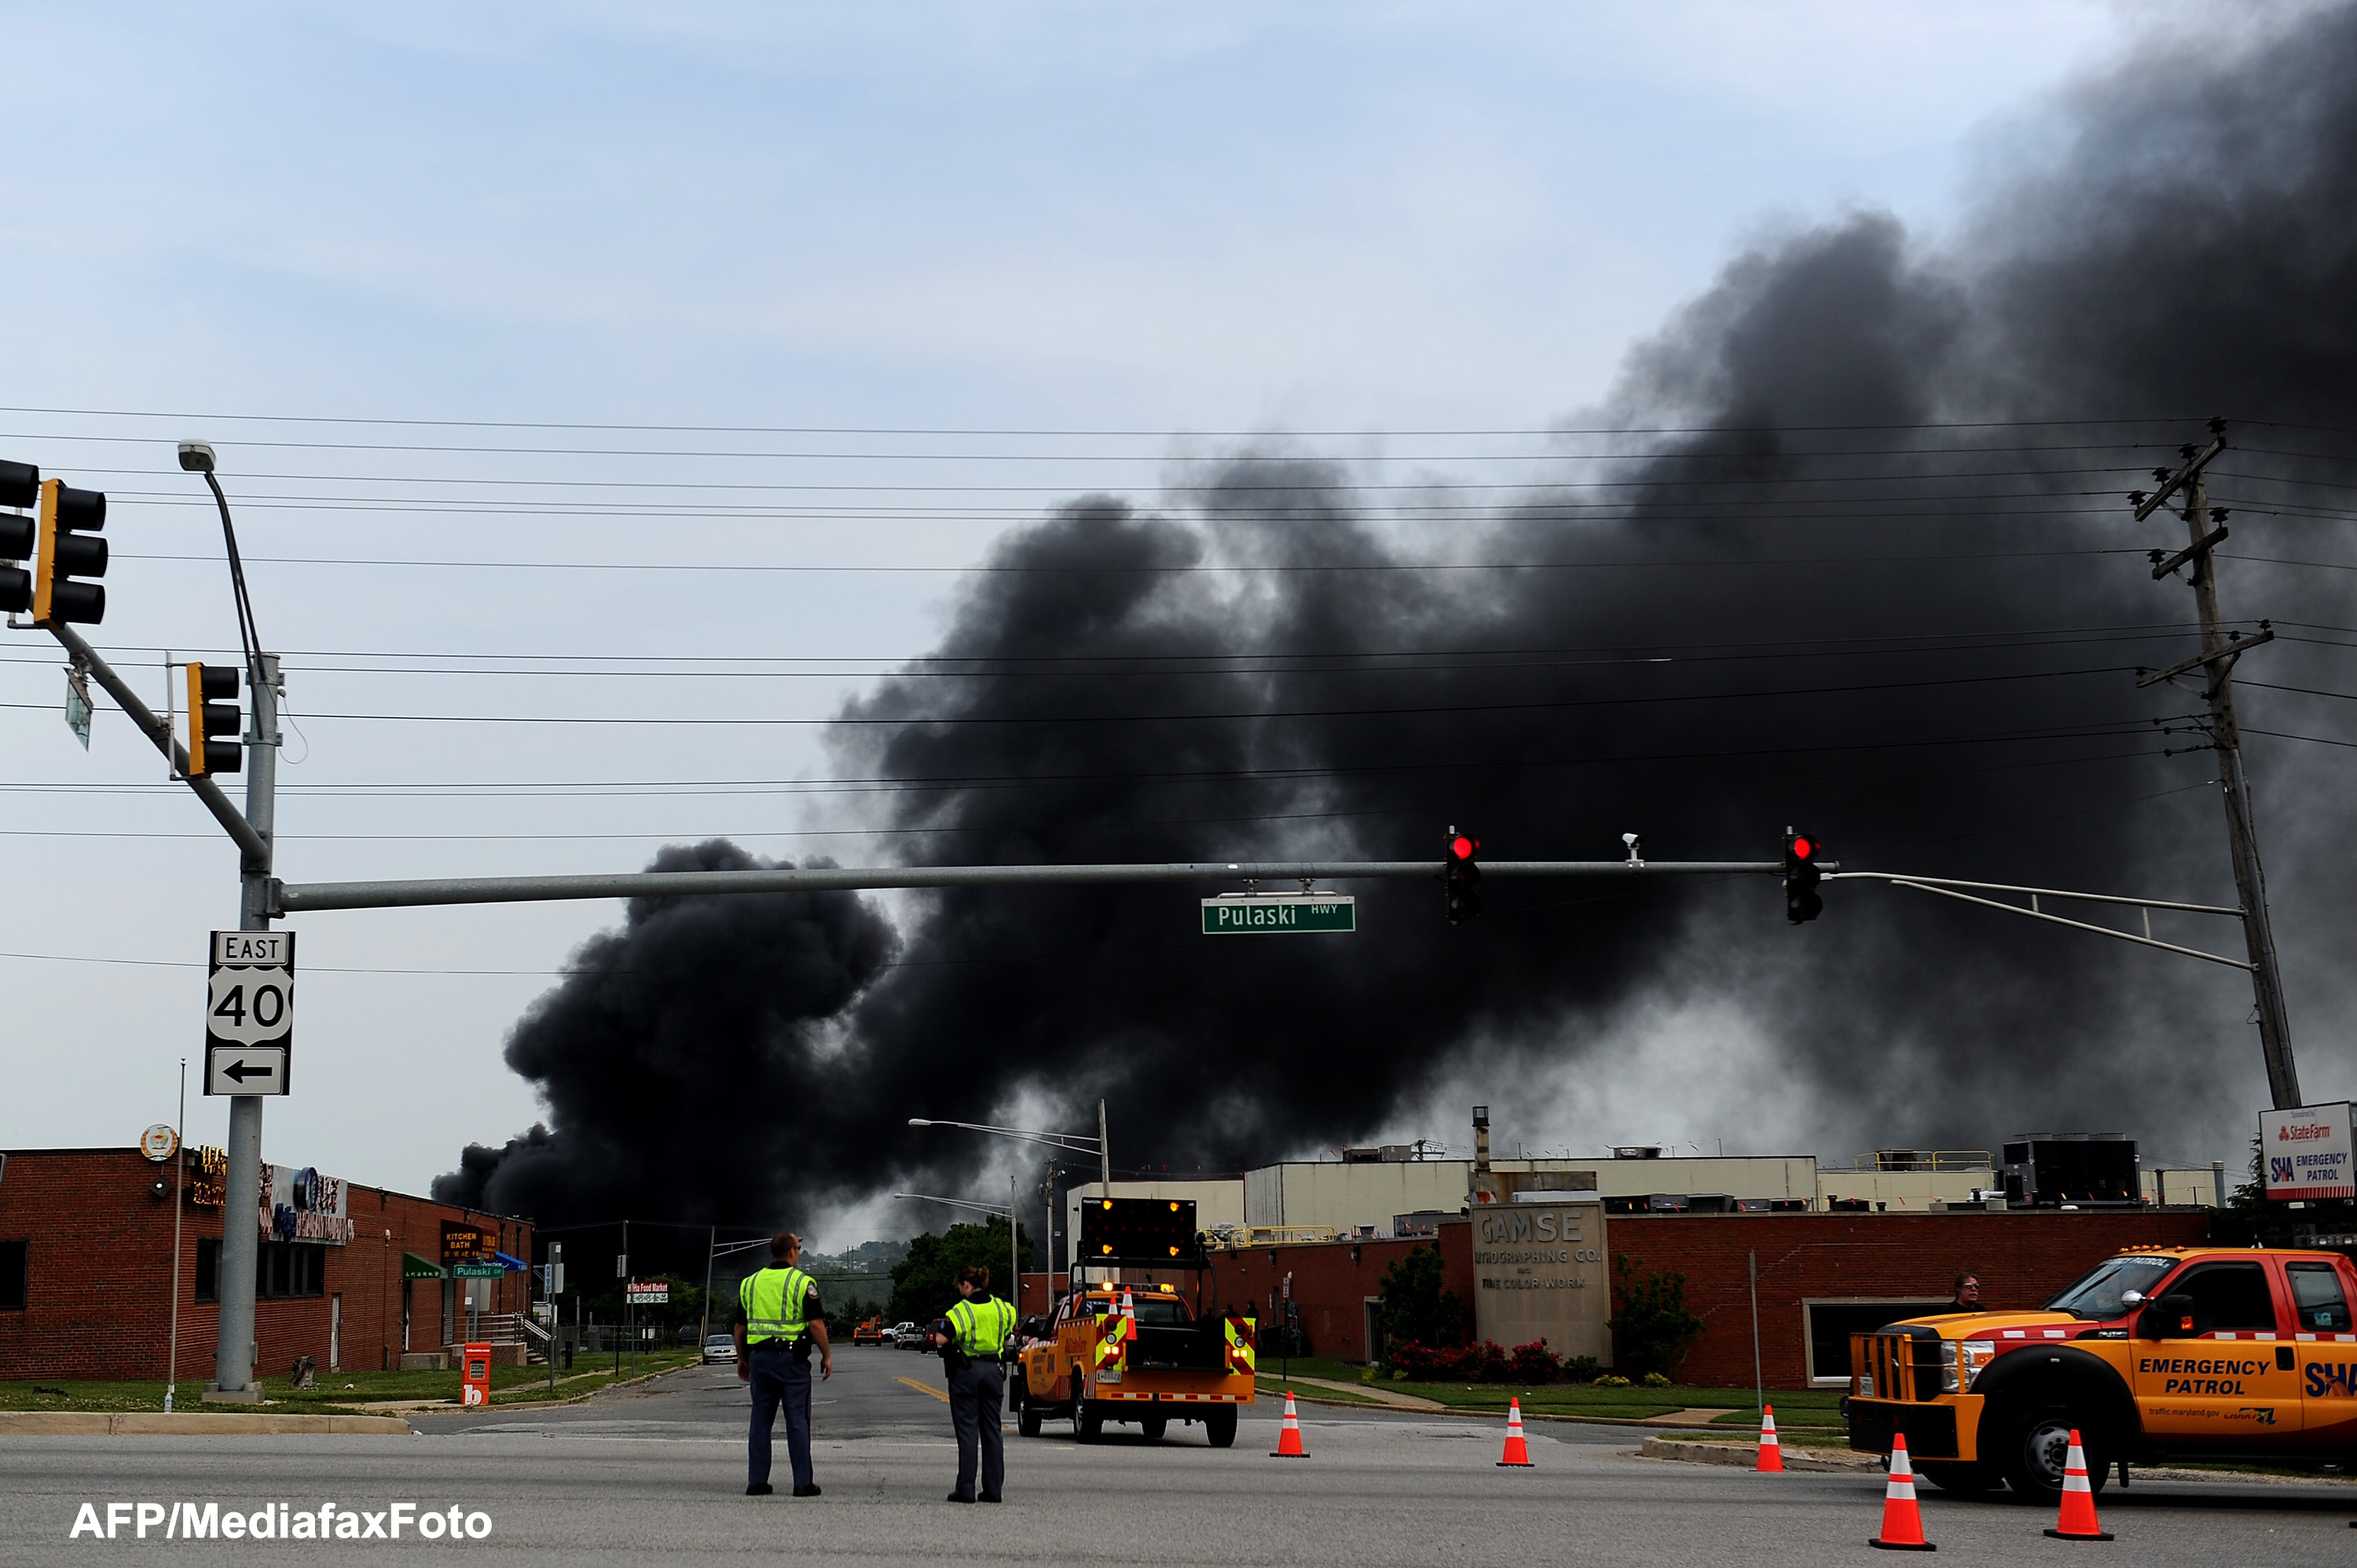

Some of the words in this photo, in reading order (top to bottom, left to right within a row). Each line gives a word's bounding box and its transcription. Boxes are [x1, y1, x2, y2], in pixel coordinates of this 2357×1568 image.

[1219, 905, 1296, 925] Pulaski
[1311, 904, 1338, 914] HWY
[225, 937, 279, 958] EAST
[214, 984, 284, 1028] 40
[2297, 1152, 2348, 1167] EMERGENCY
[2271, 1157, 2295, 1182] SHA
[2307, 1169, 2338, 1181] PATROL
[1483, 1212, 1582, 1243] GAMSE
[1475, 1250, 1568, 1264] LITHOGRAPHING
[1575, 1249, 1602, 1262] CO.
[457, 1267, 491, 1276] Pulaski
[640, 1283, 651, 1292] Food
[652, 1283, 668, 1292] Market
[1483, 1278, 1501, 1289] FINE
[1504, 1278, 1540, 1289] COLOR
[1545, 1277, 1585, 1289] WORK
[2139, 1358, 2271, 1375] EMERGENCY
[2165, 1379, 2245, 1395] PATROL
[2149, 1407, 2220, 1418] traffic.maryland.gov
